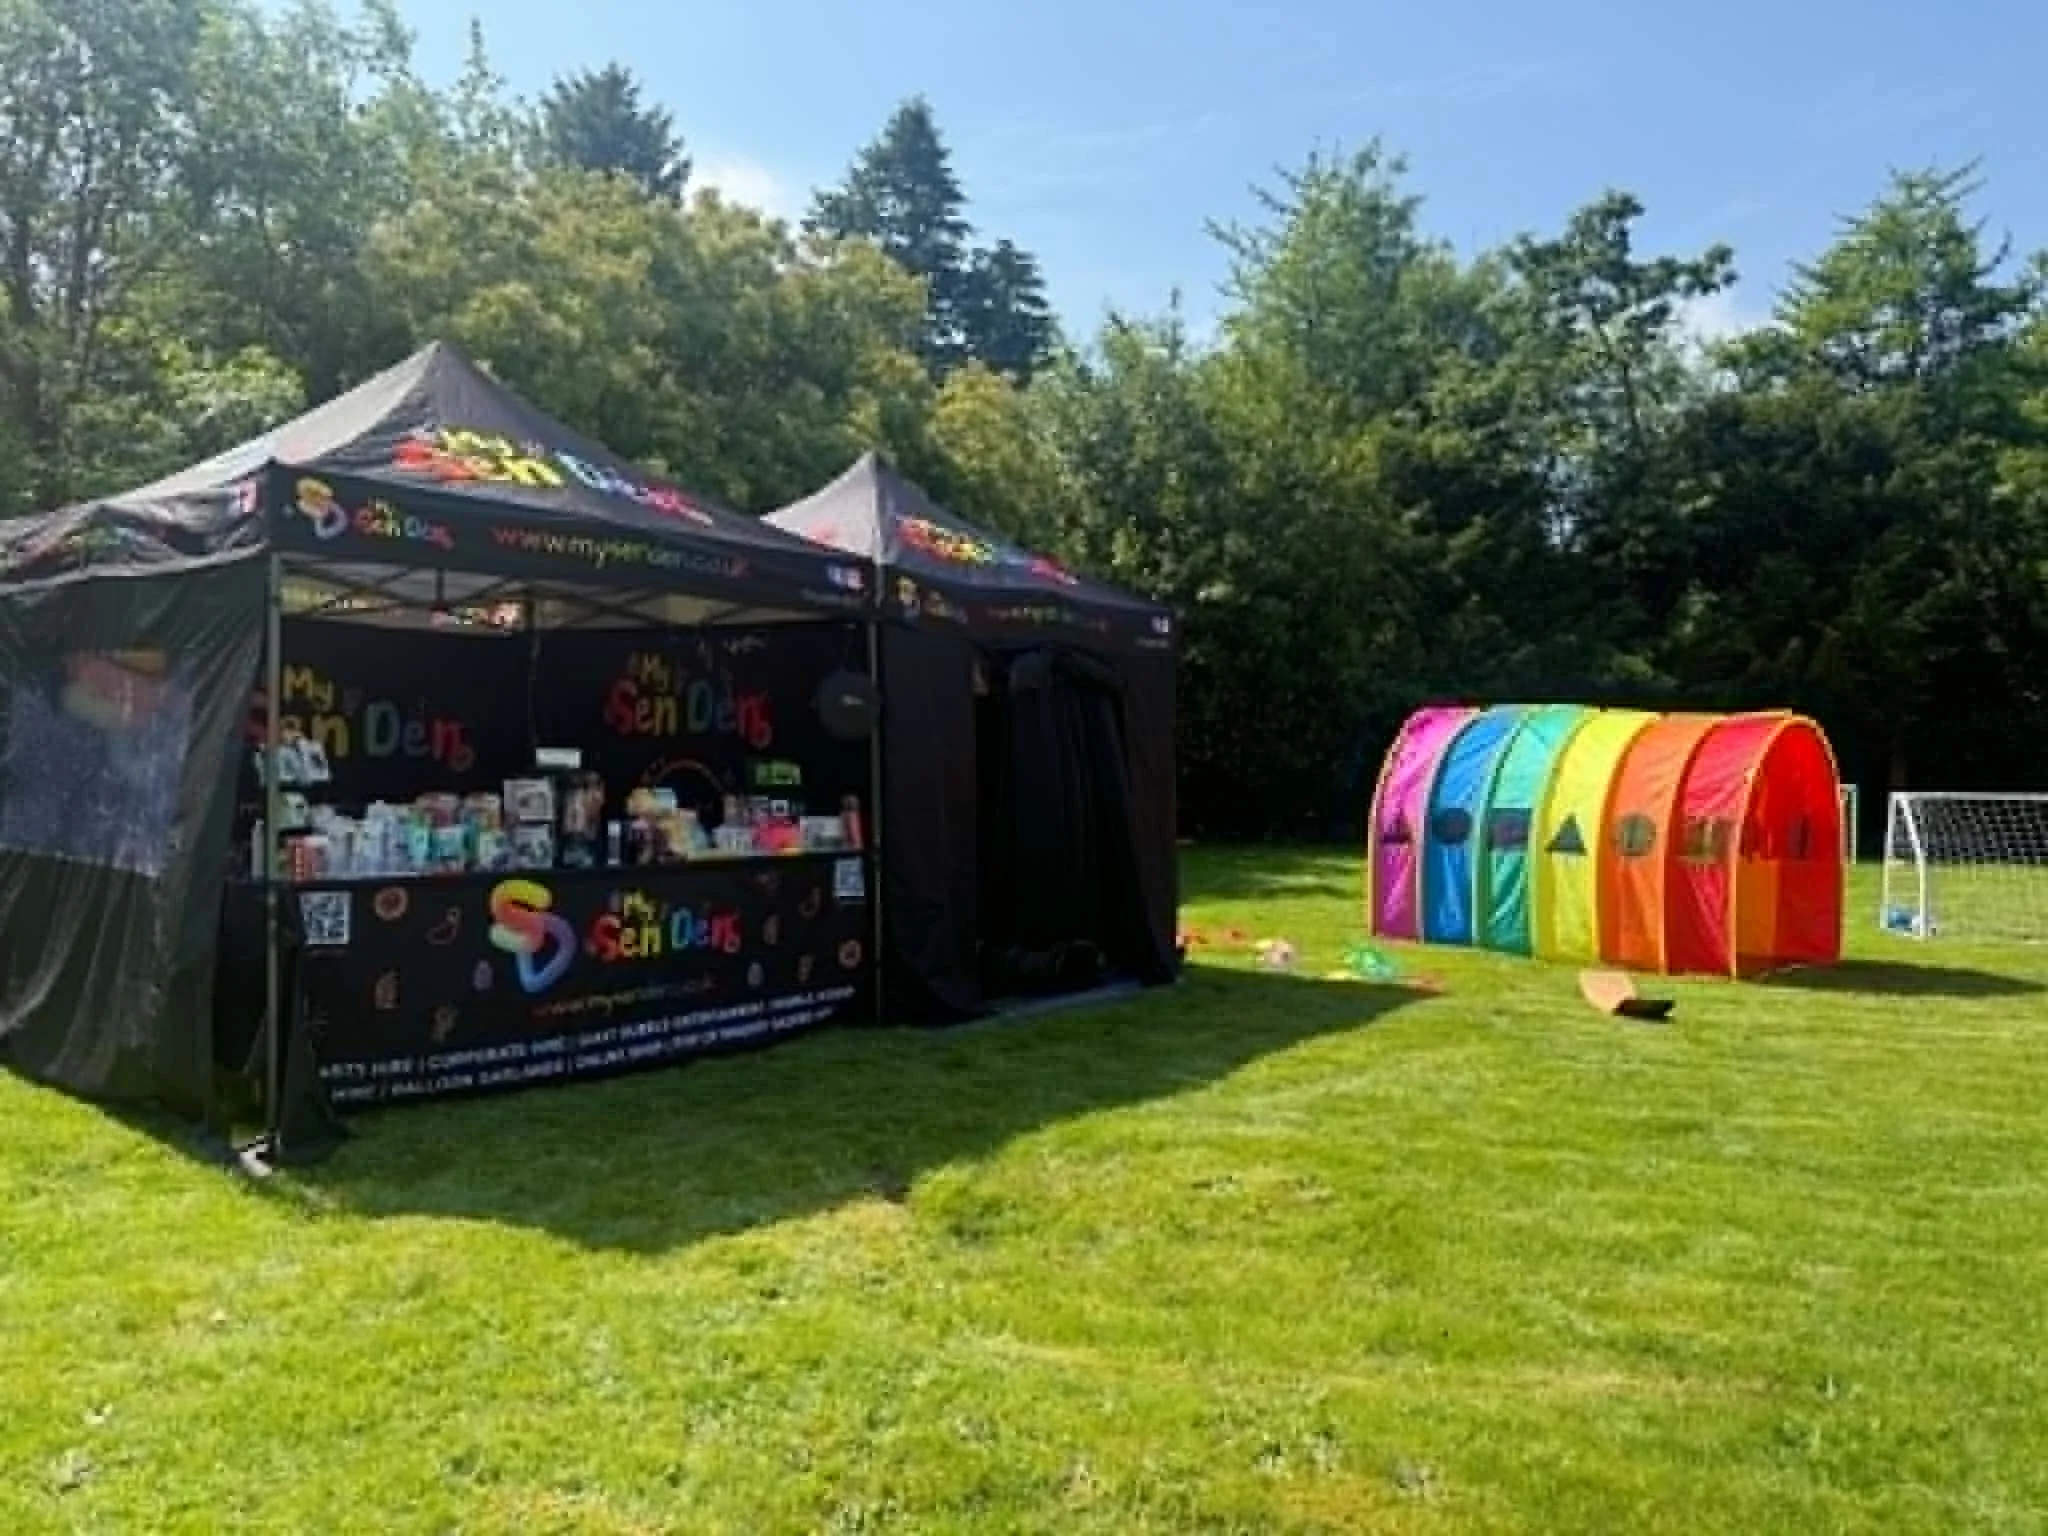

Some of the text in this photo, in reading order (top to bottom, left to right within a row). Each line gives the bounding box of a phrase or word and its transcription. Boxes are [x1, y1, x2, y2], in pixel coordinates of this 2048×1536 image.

[281, 663, 336, 713] My
[606, 677, 776, 750] Sen Den
[363, 698, 478, 773] Den
[592, 902, 744, 962] Sen Den
